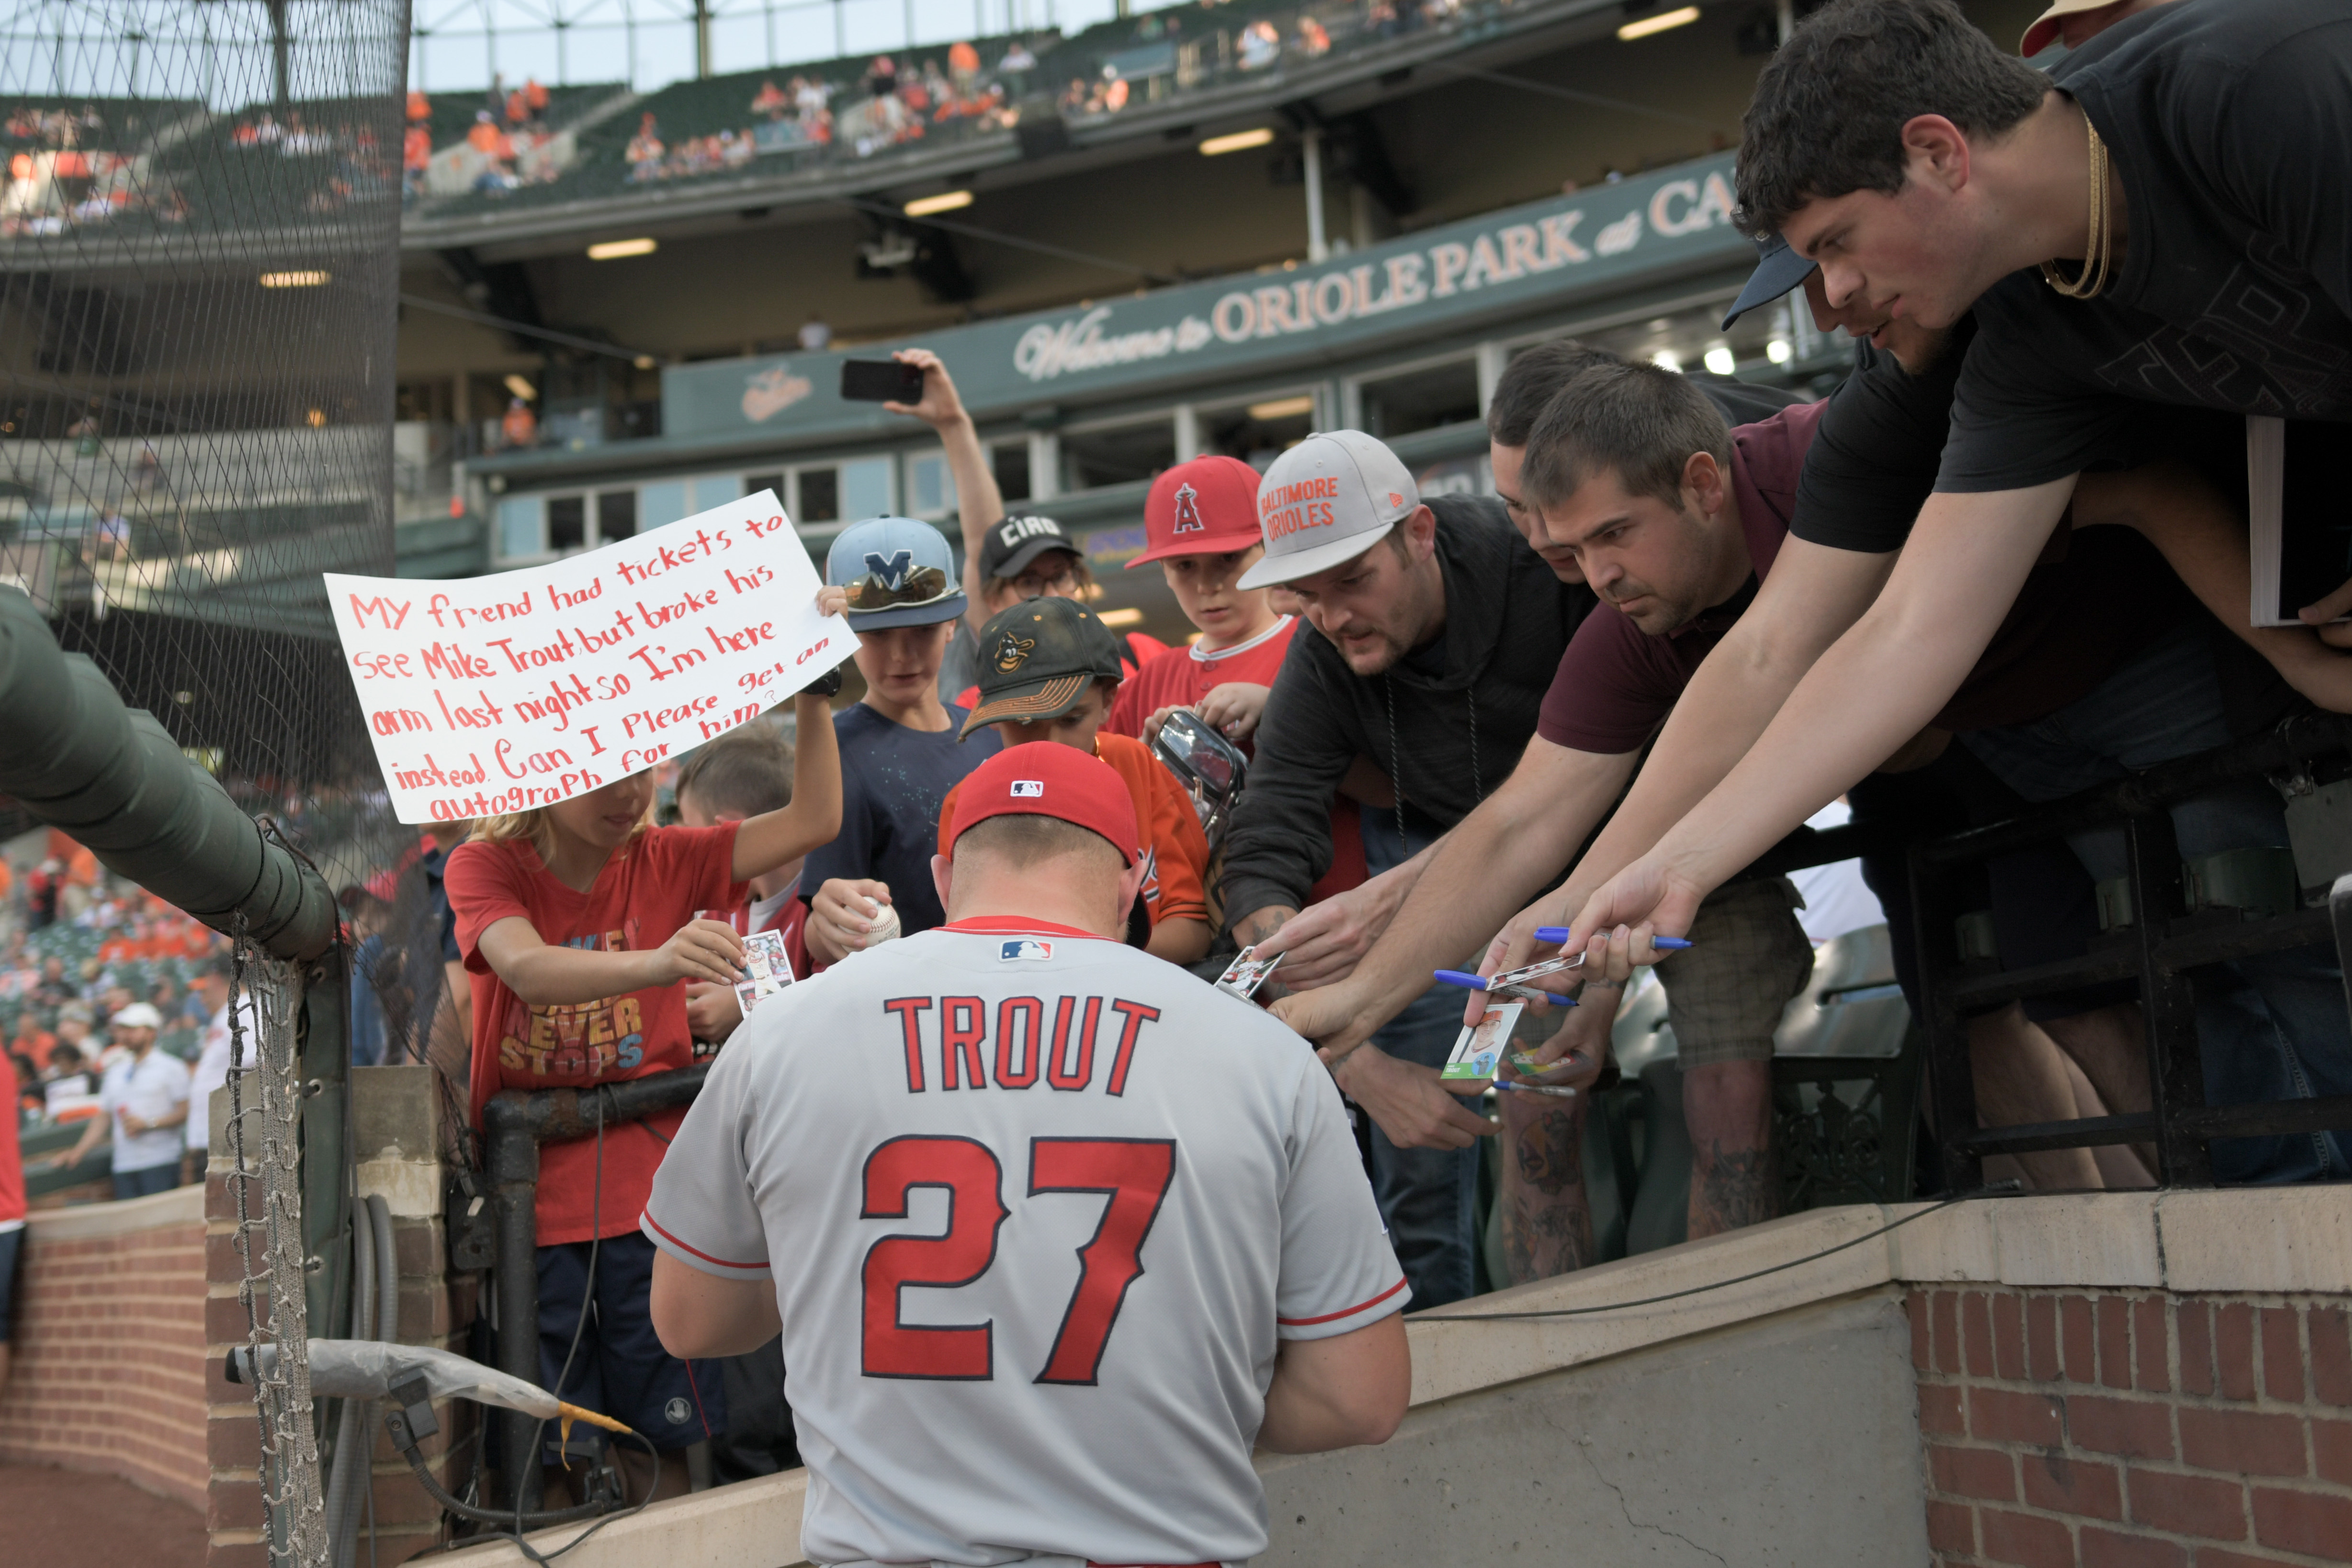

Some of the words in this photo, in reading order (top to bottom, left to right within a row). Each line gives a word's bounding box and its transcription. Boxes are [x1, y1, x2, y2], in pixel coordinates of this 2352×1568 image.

[1211, 253, 1429, 343] ORIOLE
[1428, 209, 1590, 298] PARK
[1173, 482, 1205, 534] A
[1261, 477, 1338, 518] BALTIMORE
[1267, 501, 1334, 541] ORIOLES
[547, 577, 602, 611] had
[616, 529, 732, 586] tickets
[745, 515, 782, 539] to
[863, 549, 912, 592] M
[420, 642, 497, 680] Mike
[574, 609, 635, 654] but
[635, 589, 719, 629] broke
[724, 565, 774, 595] his
[372, 709, 432, 736] arm
[433, 689, 503, 731] last
[514, 673, 593, 732] night
[596, 673, 630, 700] so
[628, 644, 707, 682] I'm
[705, 621, 777, 654] here
[495, 738, 573, 779] Can
[581, 725, 607, 756] I
[738, 662, 788, 694] get
[796, 637, 829, 666] an
[619, 743, 670, 772] for
[499, 1034, 643, 1077] STOPS
[504, 998, 643, 1049] NEVER
[884, 995, 1161, 1097] TROUT
[860, 1134, 1176, 1386] 27
